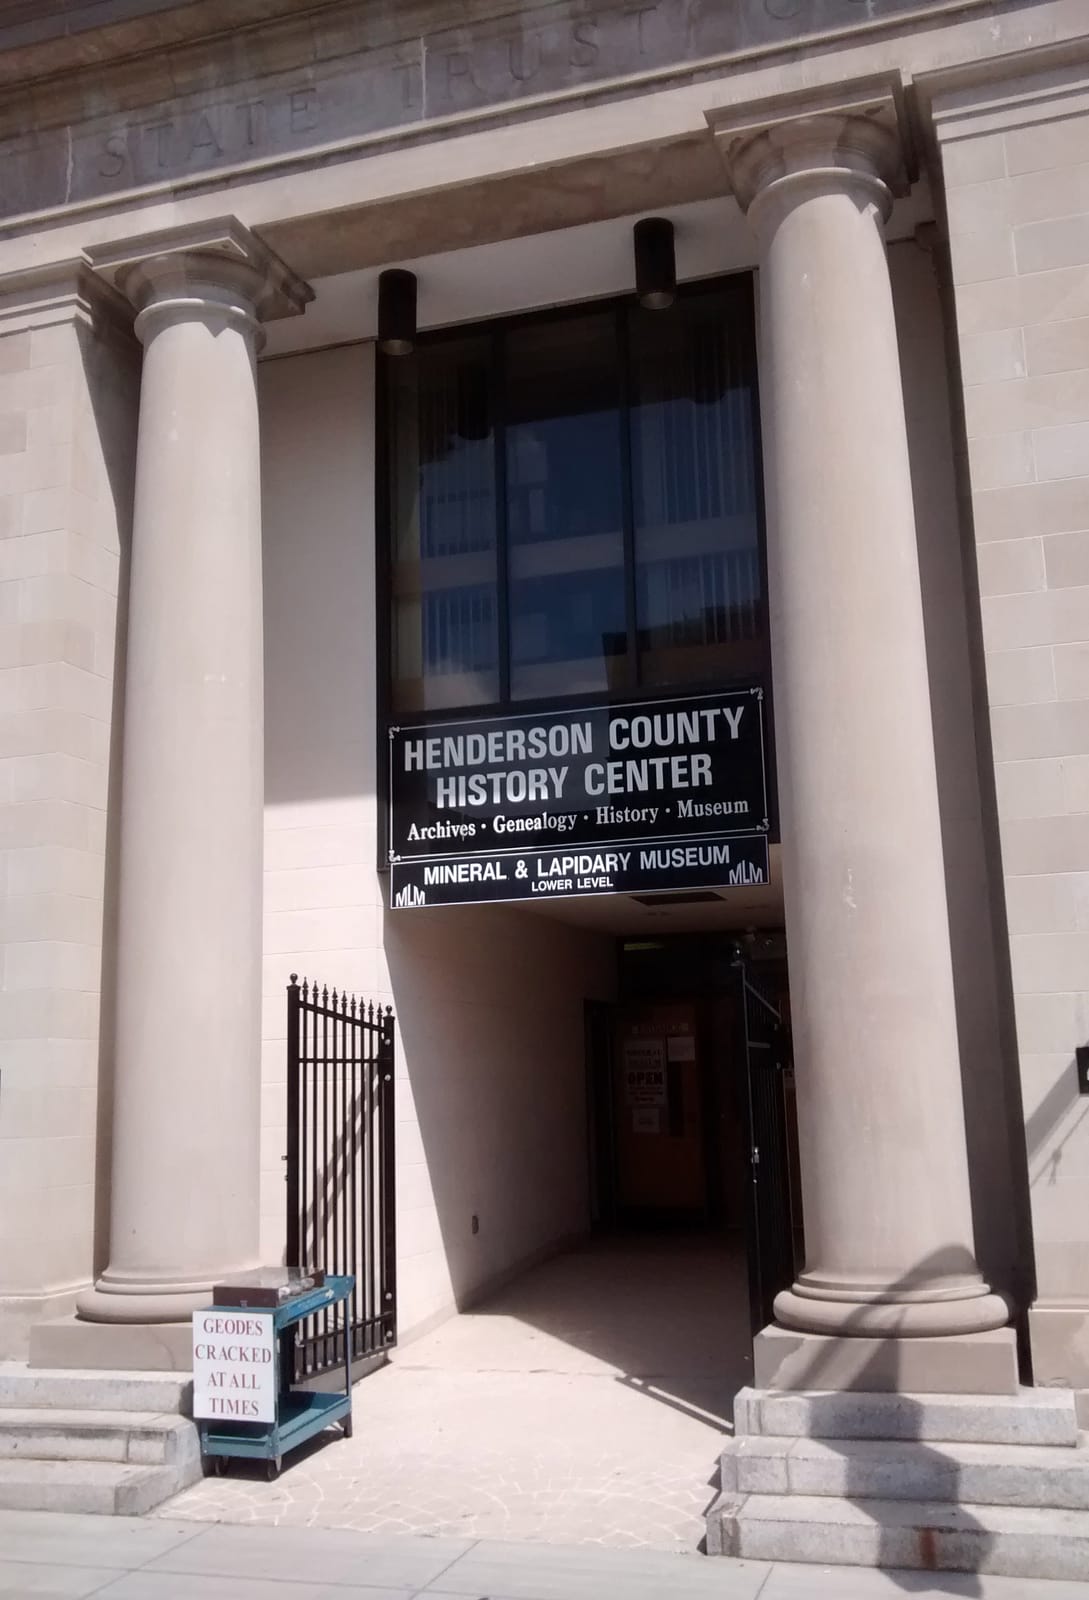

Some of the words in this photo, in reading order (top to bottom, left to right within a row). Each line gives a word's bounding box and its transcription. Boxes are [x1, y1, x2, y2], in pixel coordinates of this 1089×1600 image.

[100, 86, 318, 178] STATE
[391, 7, 658, 109] TRUST
[404, 722, 593, 772] HENDERSON
[609, 706, 745, 751] COUNTY
[436, 767, 569, 809] HISTORY
[584, 753, 713, 796] CENTER
[407, 821, 477, 842] Archives
[493, 812, 578, 835] Genealogy
[596, 806, 660, 826] History
[677, 799, 750, 819] Museum
[424, 863, 507, 887] MINERAL
[515, 860, 529, 880] &
[537, 852, 631, 877] LAPIDARY
[640, 845, 730, 870] MUSEUM
[728, 858, 763, 885] MLM
[395, 882, 426, 906] MLM
[531, 878, 573, 892] LOWER
[577, 876, 614, 890] LEVEL
[628, 1071, 664, 1086] OPEN
[203, 1318, 263, 1337] GEODES
[195, 1344, 272, 1364] CRACKED
[207, 1371, 227, 1388] AT
[231, 1373, 261, 1390] ALL
[209, 1397, 259, 1416] TIMES
